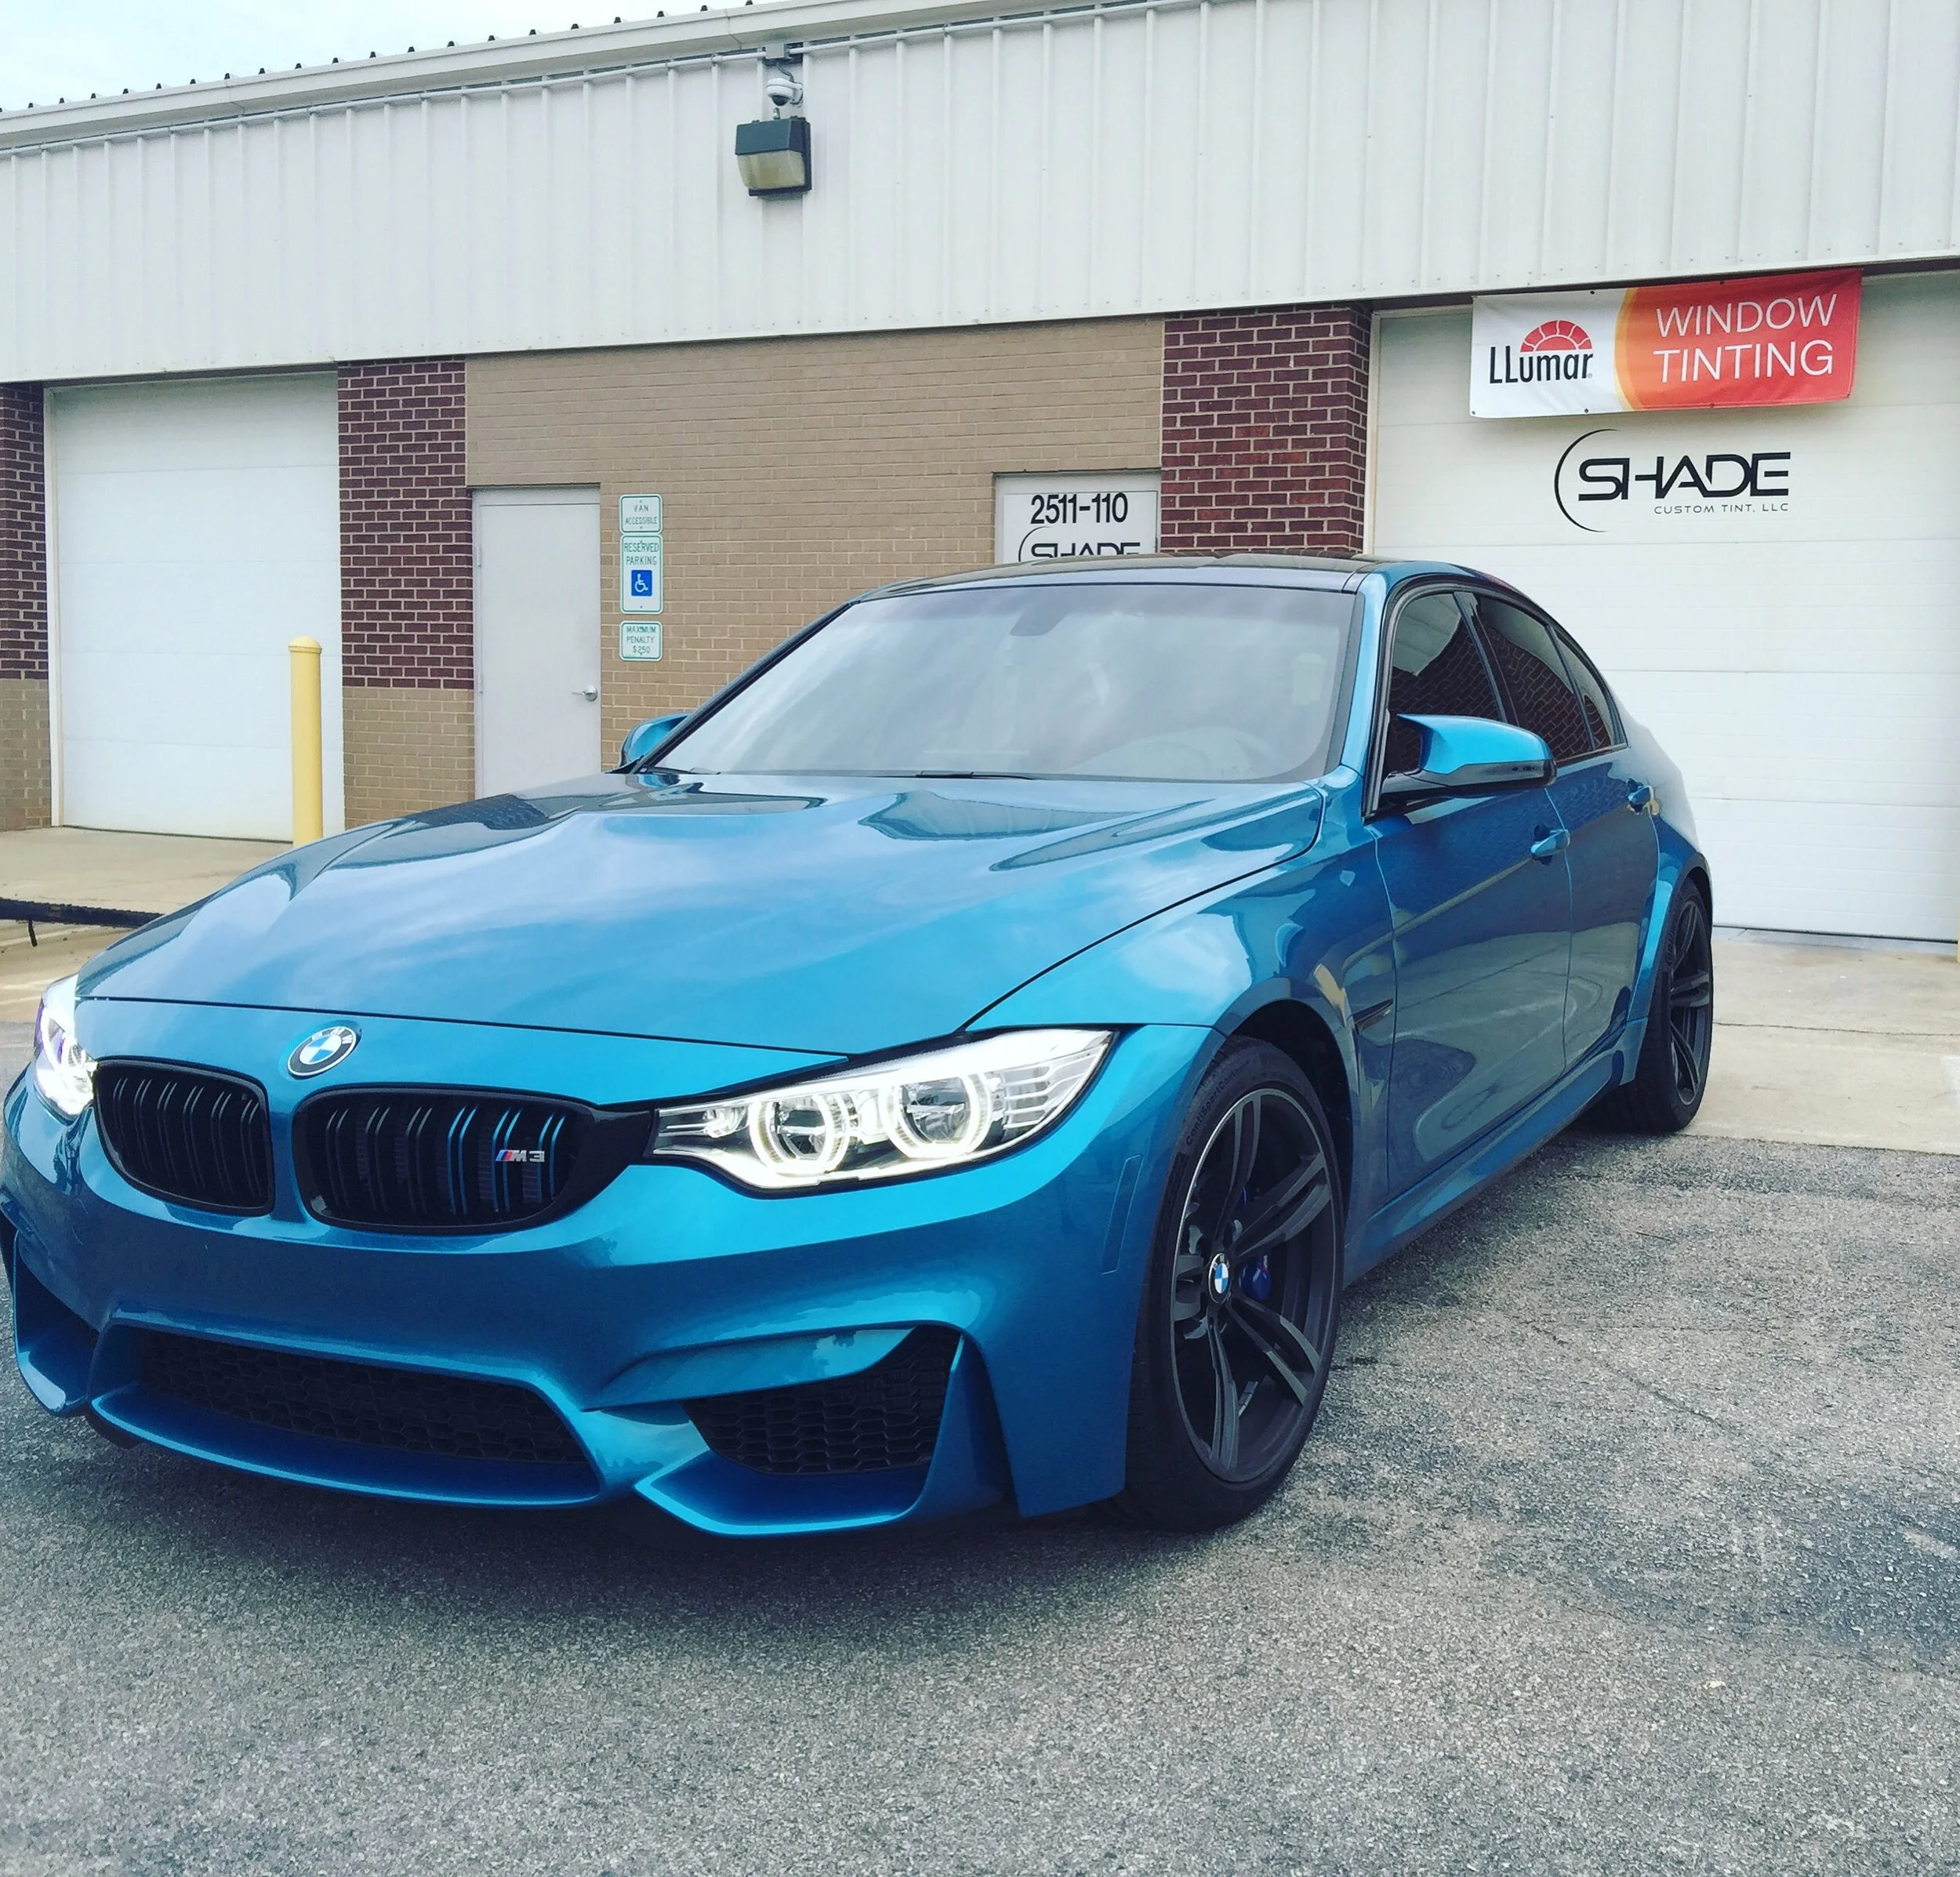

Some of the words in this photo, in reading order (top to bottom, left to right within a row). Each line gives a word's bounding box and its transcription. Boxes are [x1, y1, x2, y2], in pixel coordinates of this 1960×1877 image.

[1656, 294, 1837, 338] WINDOW
[1490, 346, 1593, 383] LLumar
[1653, 339, 1833, 383] TINTING
[1578, 452, 1791, 501] SHADE
[1030, 492, 1128, 524] 2511-110
[1654, 505, 1714, 514] CUSTOM
[1762, 503, 1788, 512] LLC
[624, 543, 659, 552] RESERVED
[626, 555, 657, 565] PARKING
[633, 646, 650, 655] $250
